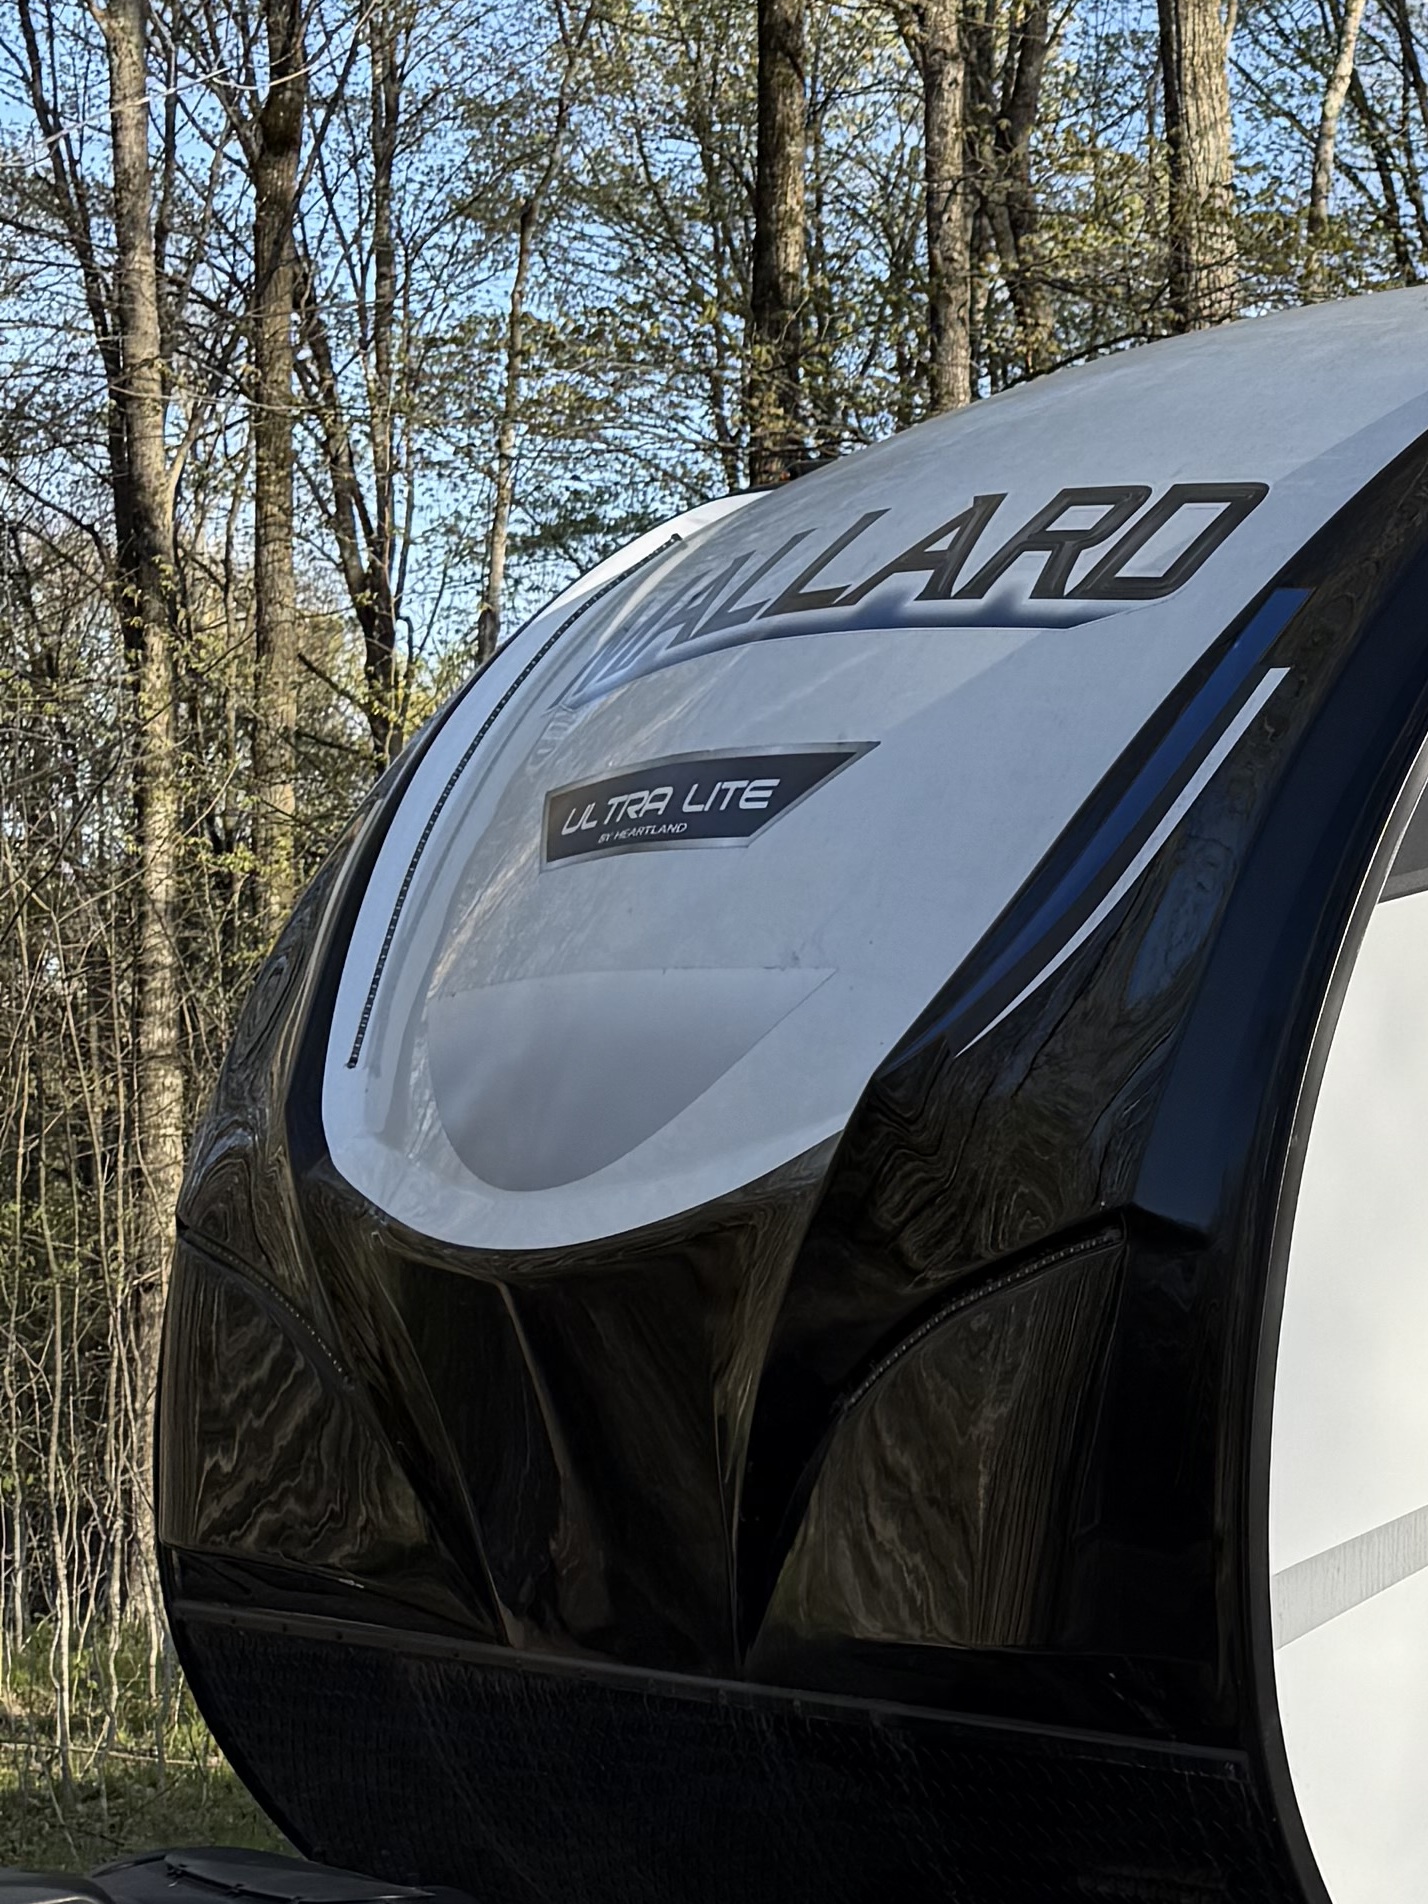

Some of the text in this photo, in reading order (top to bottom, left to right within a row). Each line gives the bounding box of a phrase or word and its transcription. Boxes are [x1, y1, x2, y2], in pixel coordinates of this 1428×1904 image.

[546, 482, 1269, 711] MALLARD
[561, 778, 781, 836] ULTRA LITE
[614, 822, 688, 840] HEARTLAND
